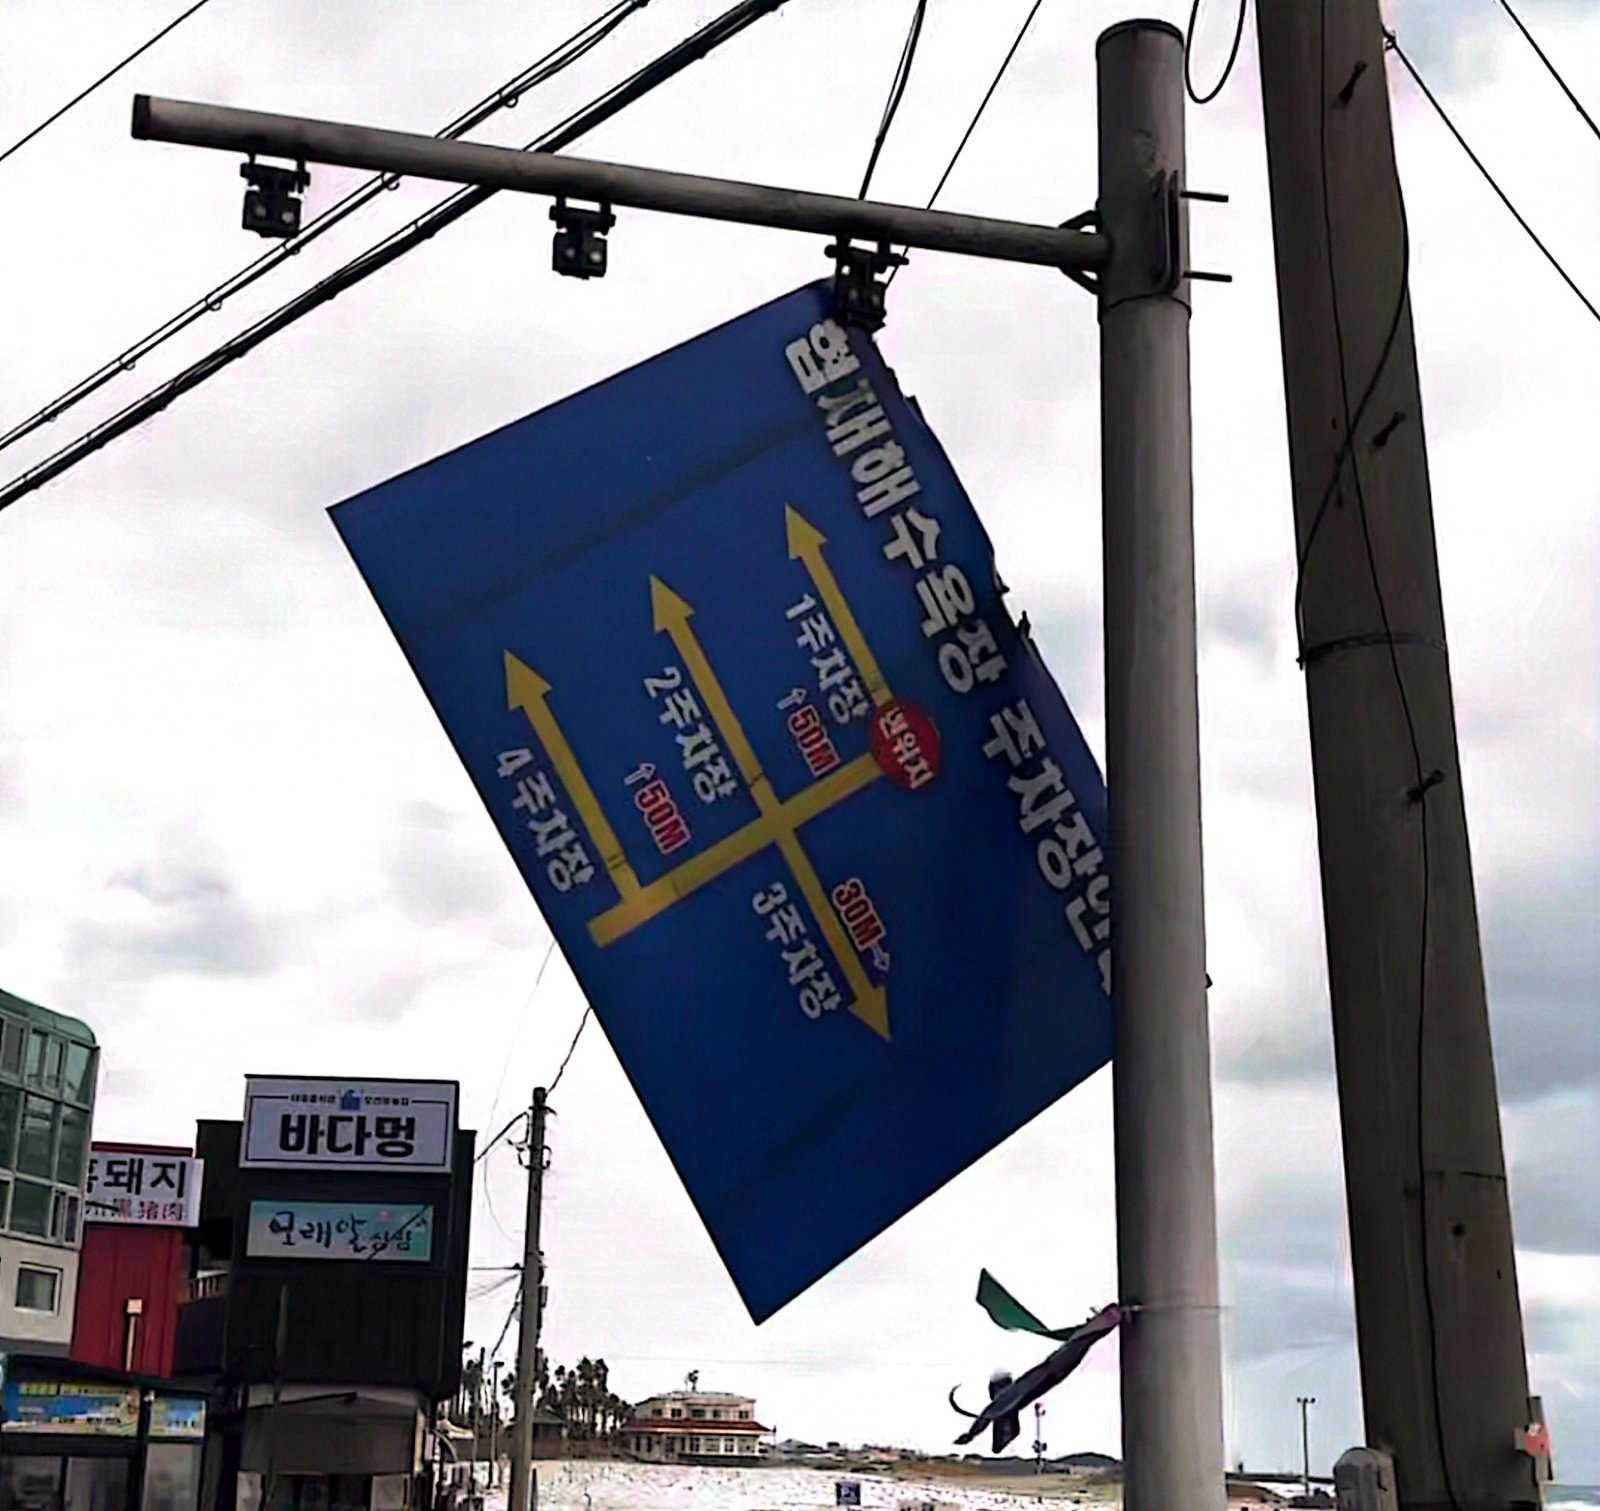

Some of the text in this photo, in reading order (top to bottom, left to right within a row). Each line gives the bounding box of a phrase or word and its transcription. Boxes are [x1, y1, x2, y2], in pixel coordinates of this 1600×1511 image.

[785, 318, 1111, 997] 협재해수욕장 주차장안
[785, 593, 871, 724] 1주차장
[644, 667, 738, 803] 2주차장
[786, 704, 842, 778] 50M
[634, 780, 692, 855] 50M
[752, 882, 841, 1020] 3주차장
[831, 877, 886, 952] 30M
[279, 1113, 416, 1158] 바다멍
